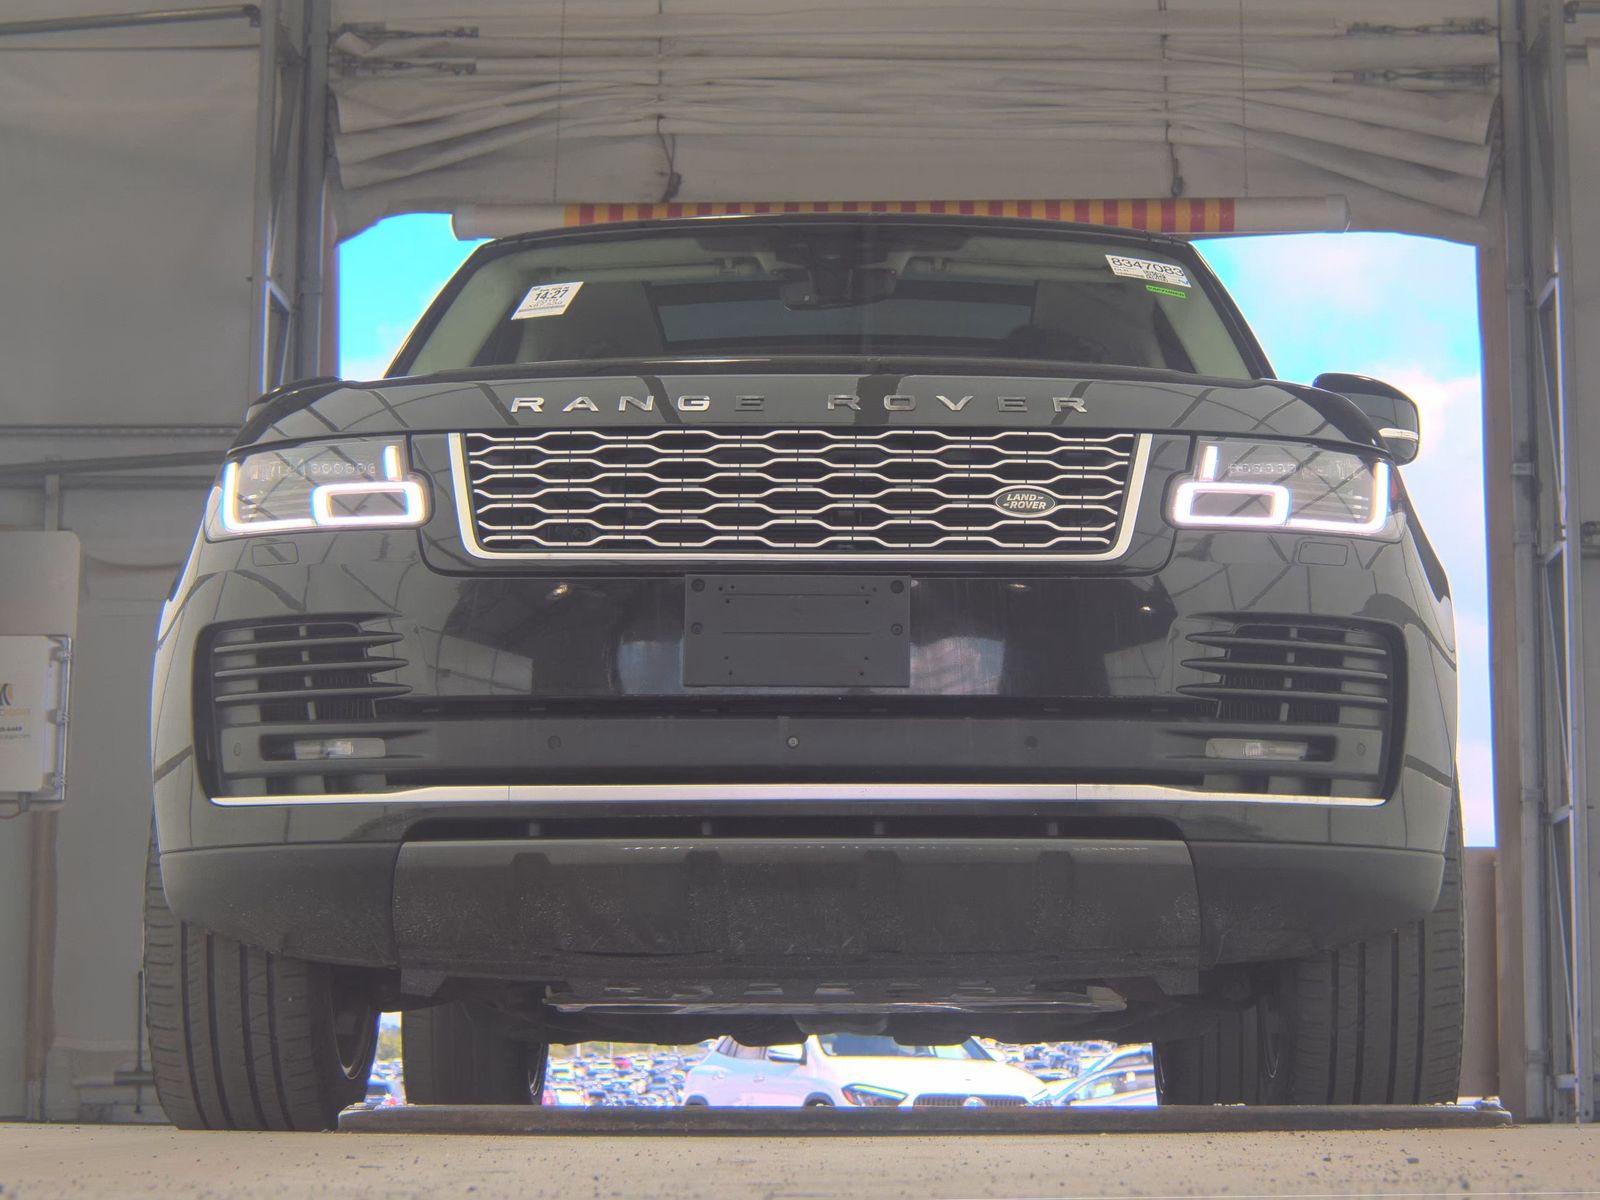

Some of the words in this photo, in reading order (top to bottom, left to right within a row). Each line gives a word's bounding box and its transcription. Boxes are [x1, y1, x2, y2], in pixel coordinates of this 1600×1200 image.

[1111, 257, 1185, 277] 8347083
[534, 289, 569, 301] 14:27
[510, 395, 765, 413] RANGE
[827, 394, 1088, 413] ROVER
[1006, 493, 1037, 501] LAND
[1009, 501, 1047, 510] ROVER
